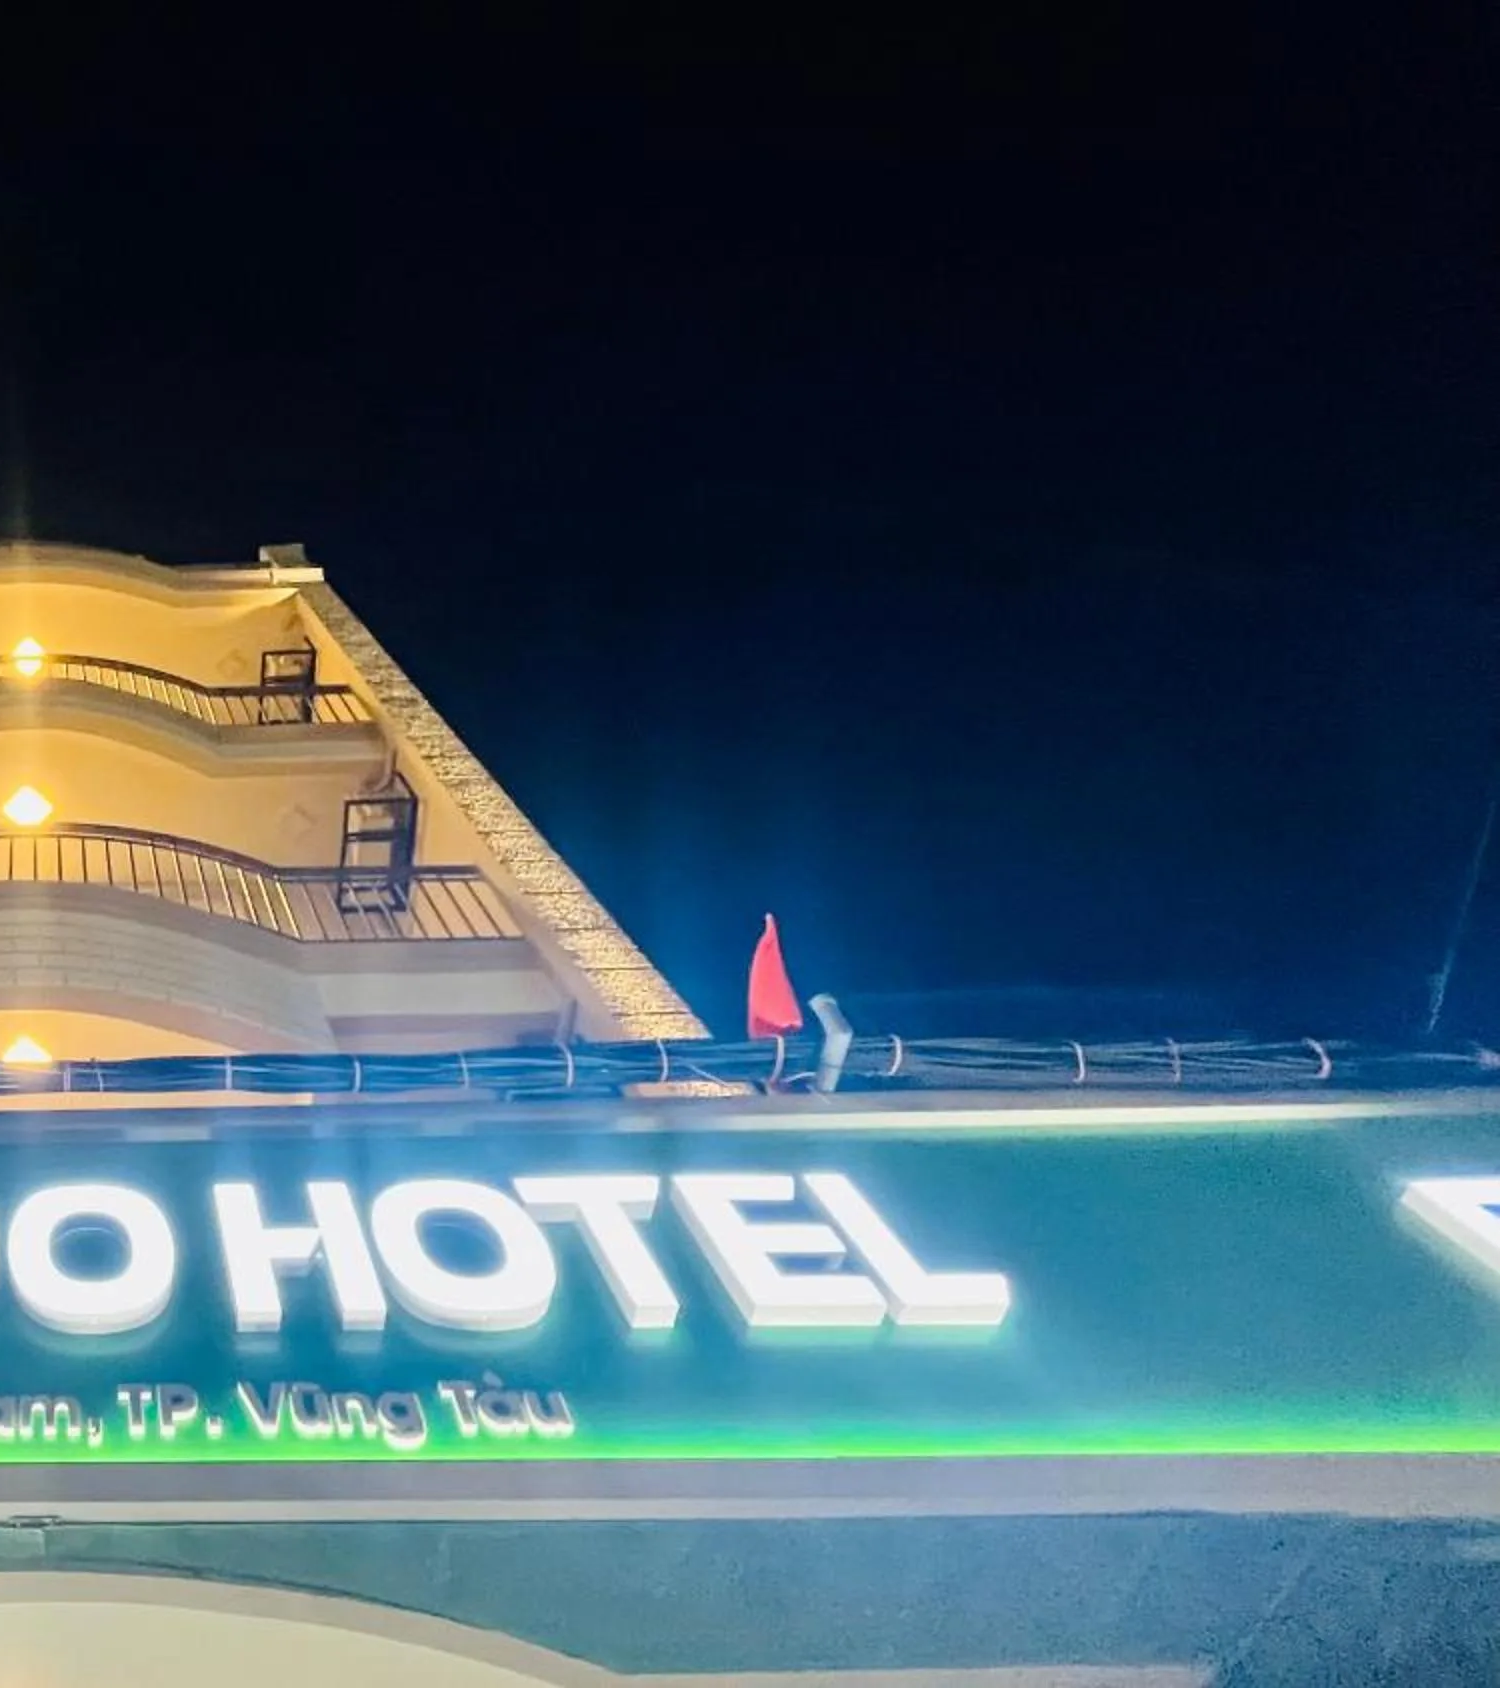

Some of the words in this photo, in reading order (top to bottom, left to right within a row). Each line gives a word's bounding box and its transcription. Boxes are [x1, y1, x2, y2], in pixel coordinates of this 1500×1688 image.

[211, 1172, 1010, 1334] HOTEL
[117, 1383, 223, 1440] TP.
[436, 1369, 575, 1438] Tàu
